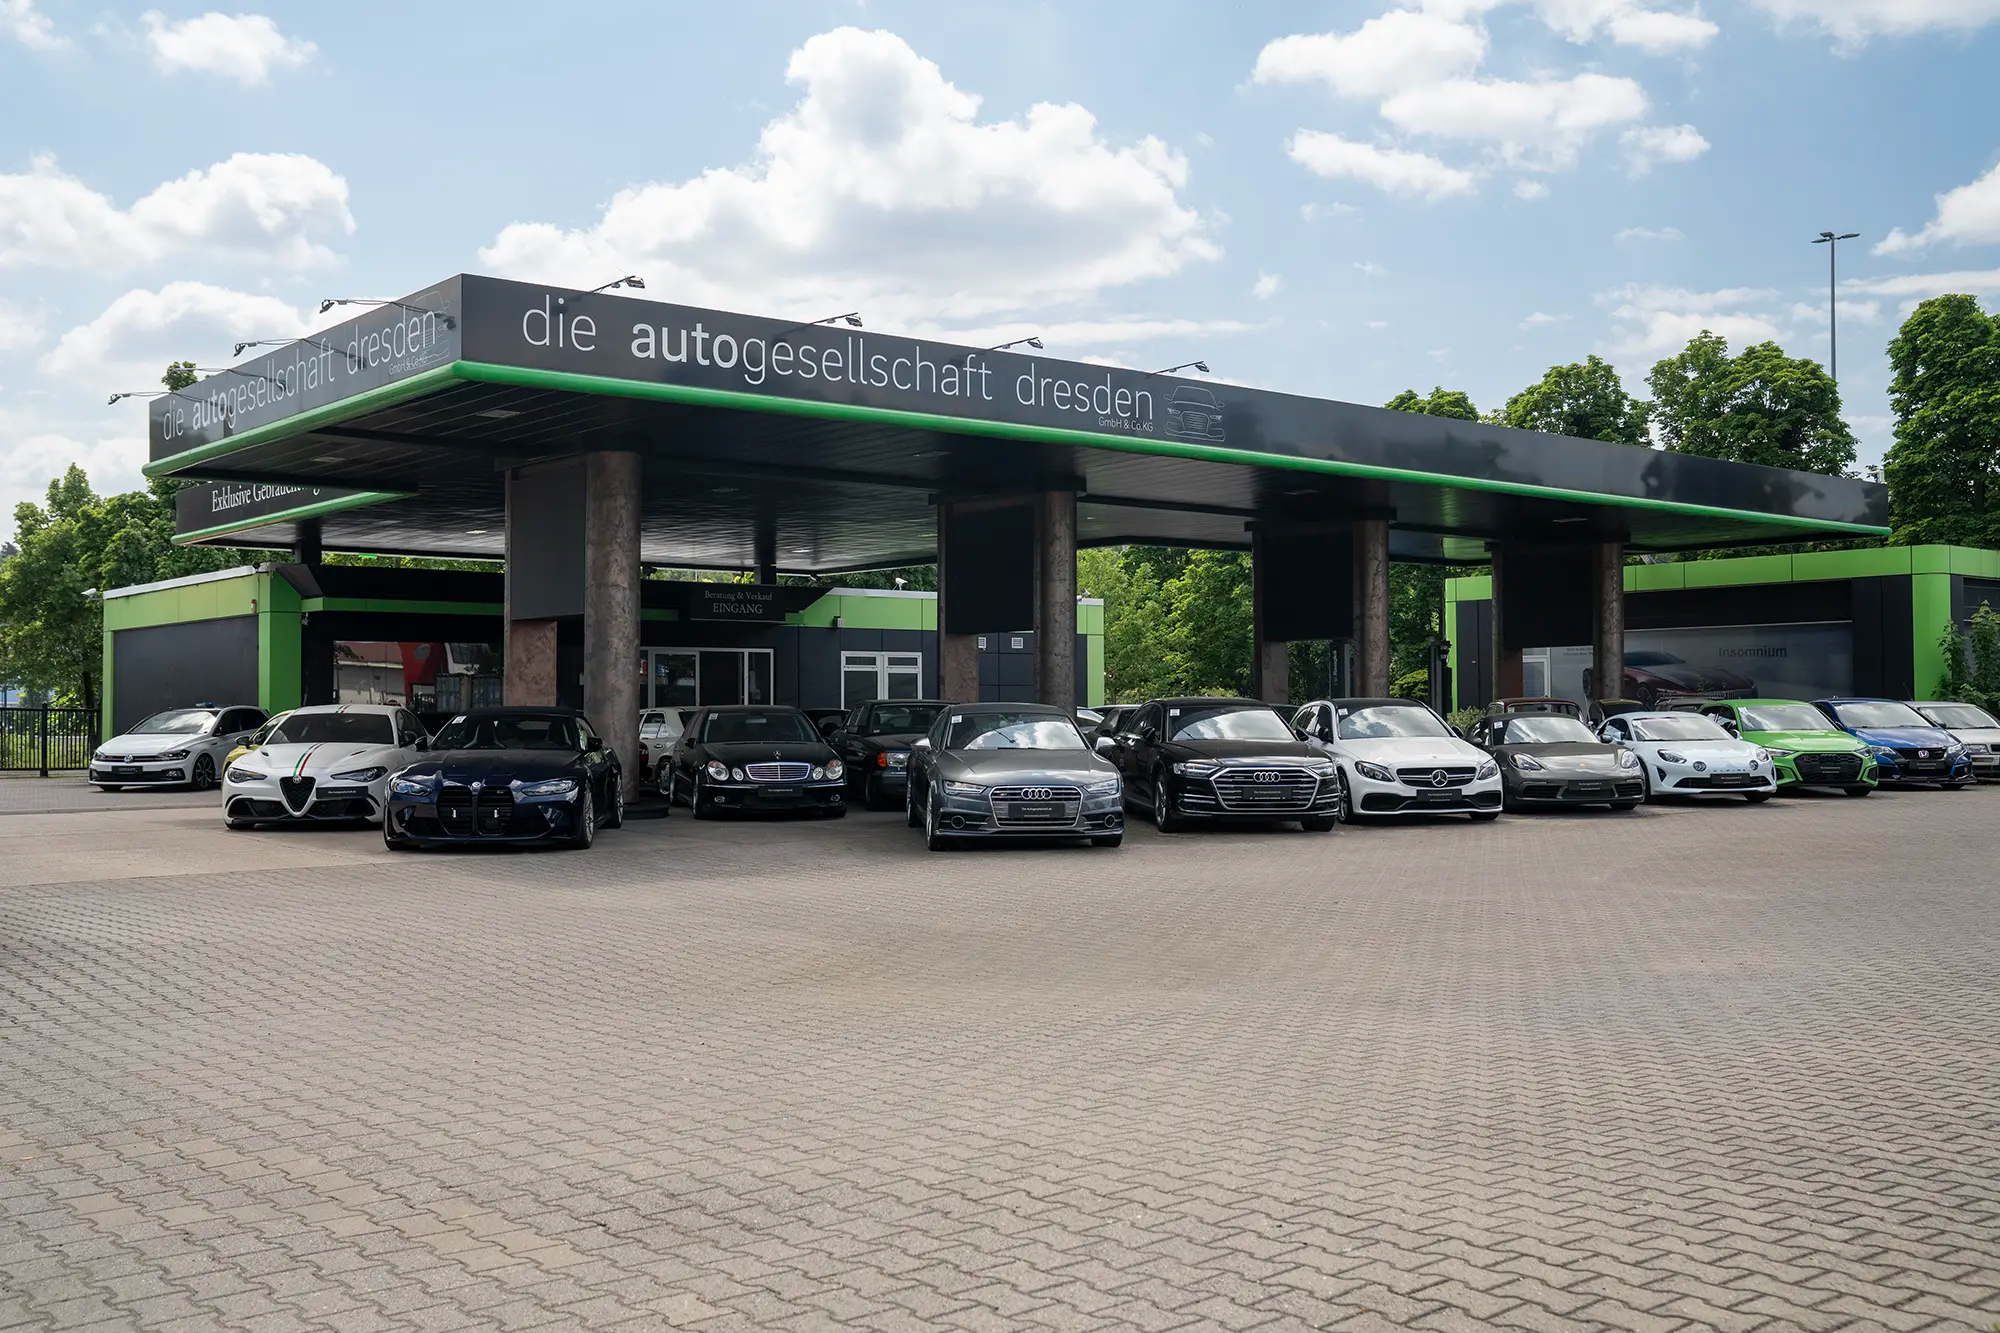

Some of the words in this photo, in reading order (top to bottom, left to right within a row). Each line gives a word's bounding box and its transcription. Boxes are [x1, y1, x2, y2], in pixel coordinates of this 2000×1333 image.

[522, 294, 597, 352] die
[630, 322, 993, 401] autogesellschaft
[1016, 362, 1153, 420] dresden
[163, 399, 184, 440] die
[192, 337, 335, 429] autogesellschaft
[346, 305, 436, 376] dresden
[1098, 416, 1122, 429] GmbH
[1123, 420, 1129, 429] &
[211, 485, 251, 513] Exklusive
[704, 590, 736, 601] Beratung
[737, 592, 744, 600] &
[746, 591, 773, 601] Verkauf
[713, 602, 763, 614] EINGANG
[1718, 645, 1787, 658] Insomnium
